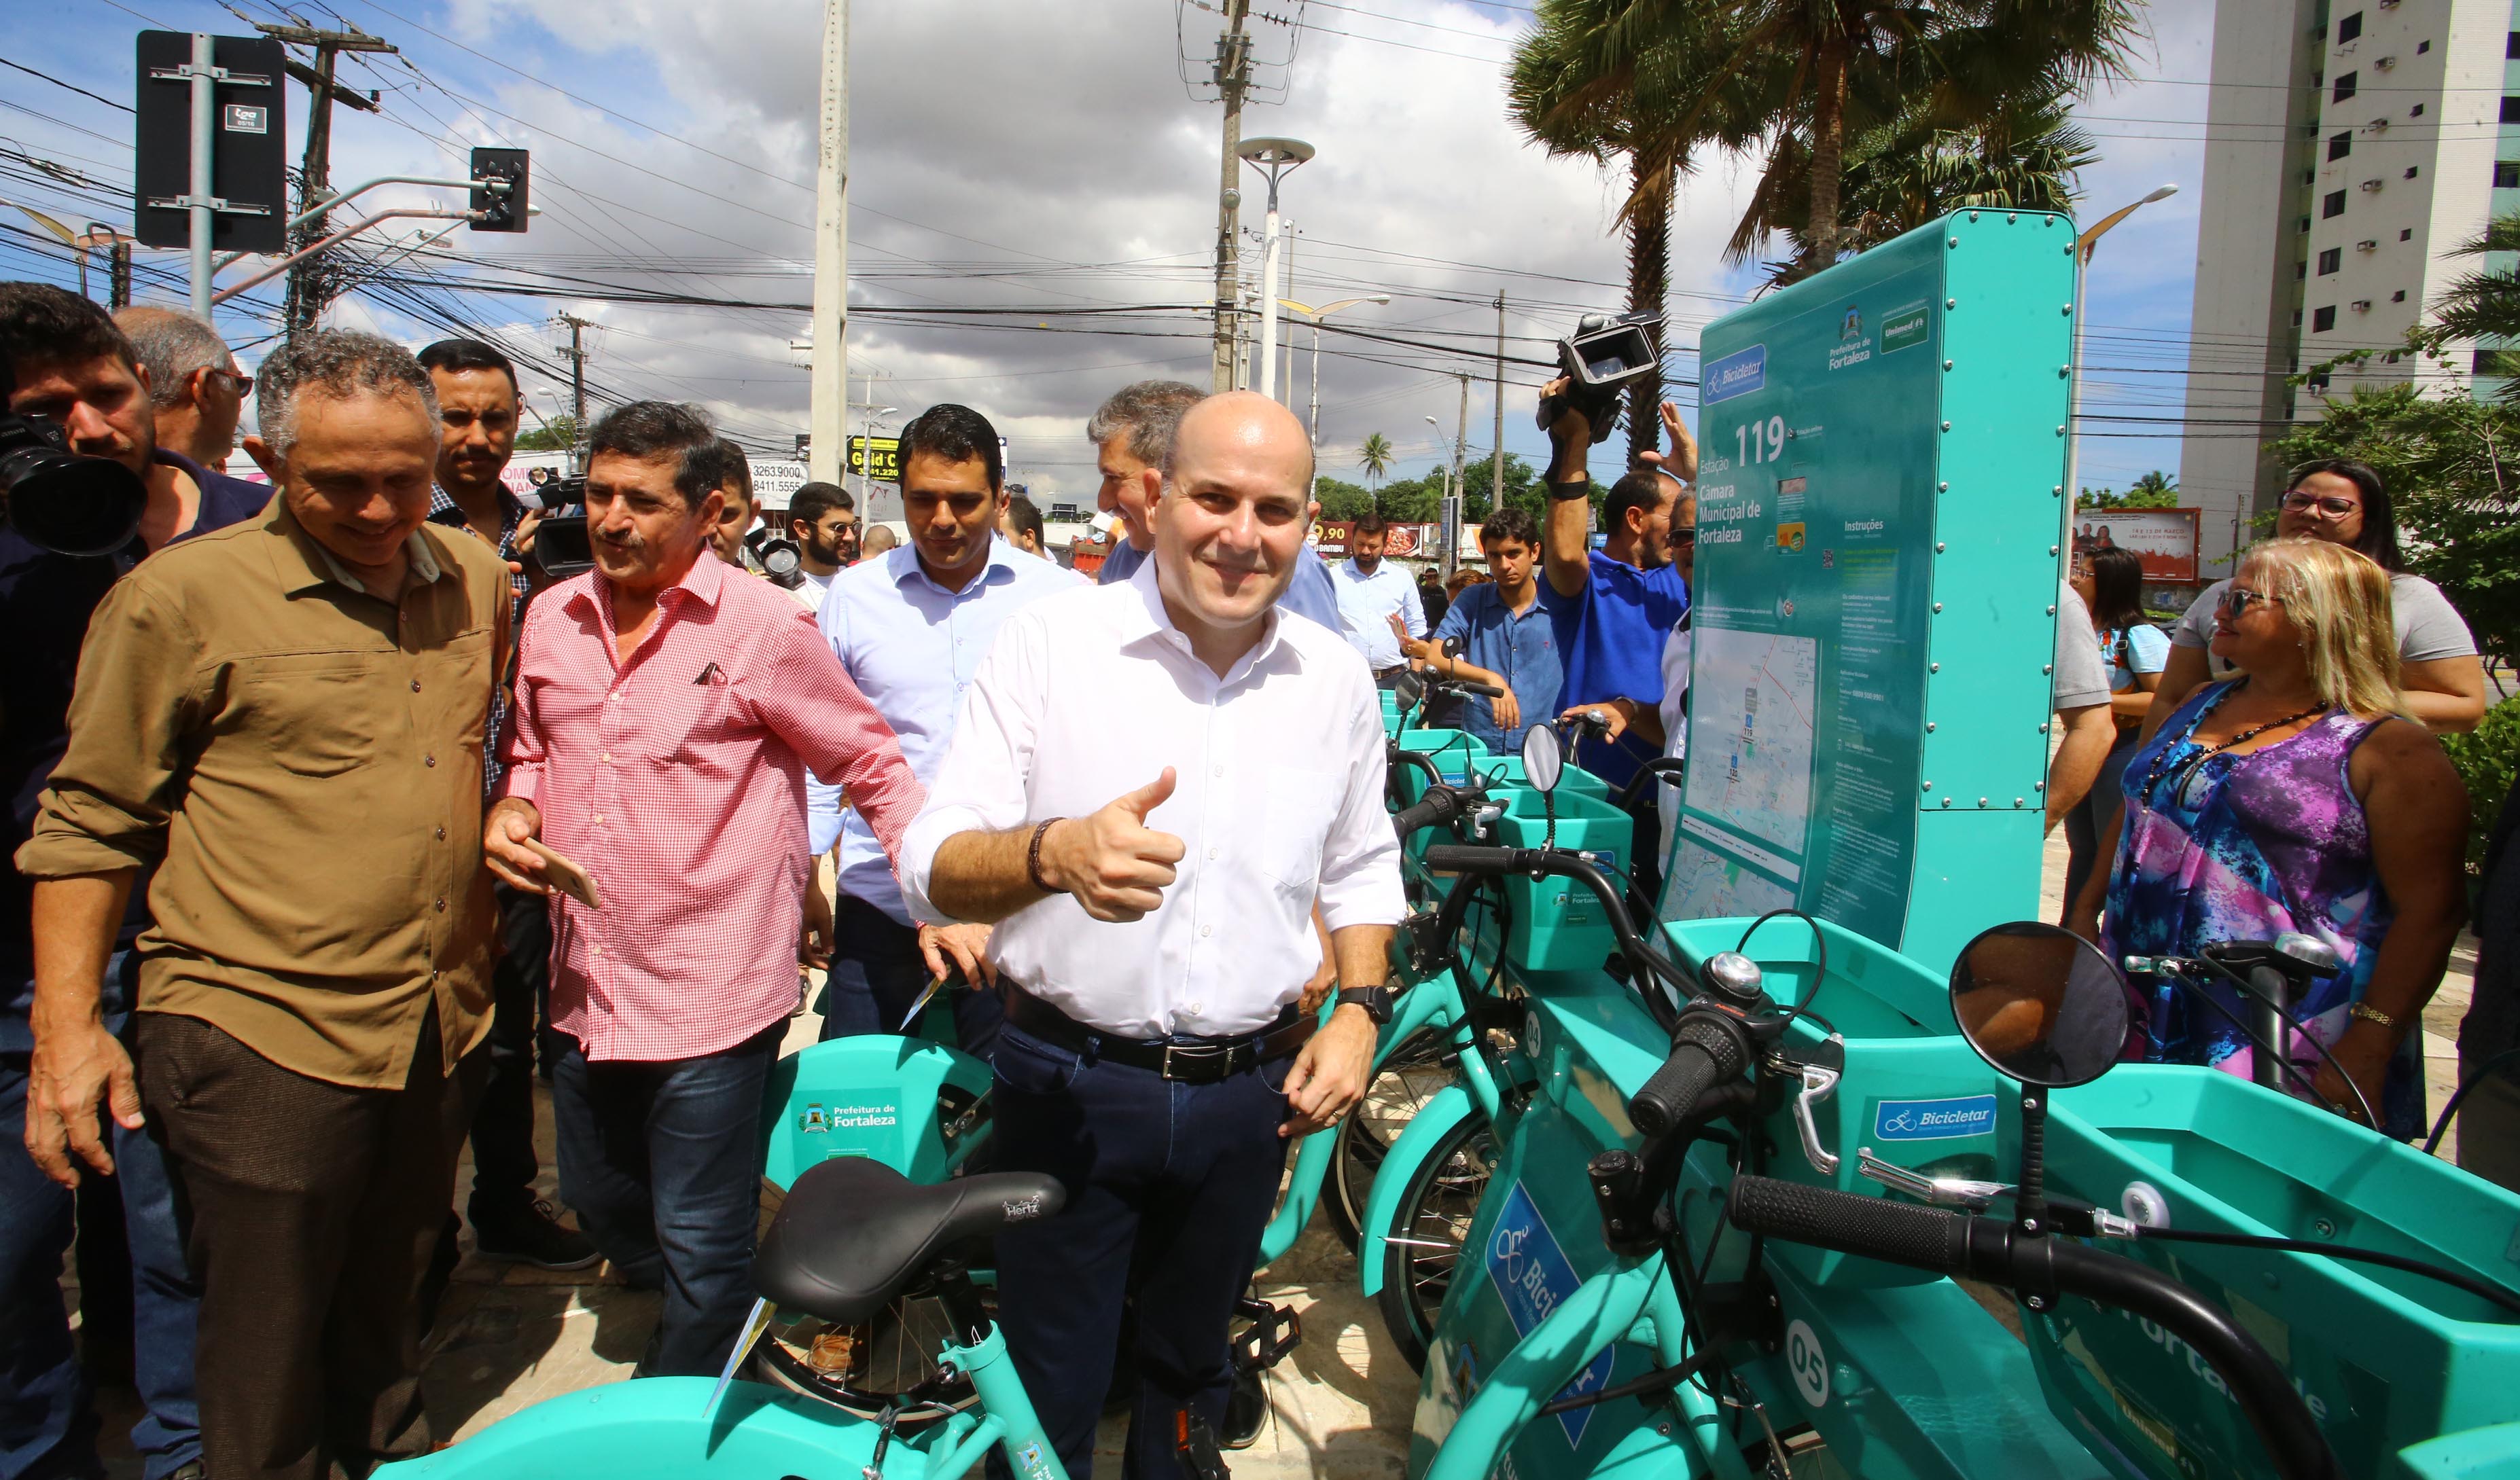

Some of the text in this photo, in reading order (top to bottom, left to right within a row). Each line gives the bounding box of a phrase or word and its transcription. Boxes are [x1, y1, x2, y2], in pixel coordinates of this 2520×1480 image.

[1885, 321, 1914, 337] Unimed
[1829, 337, 1871, 357] Prefeitura de
[1828, 350, 1870, 371] Fortaleza
[1722, 361, 1762, 385] Bicicletar
[1736, 416, 1785, 467] 119
[851, 452, 896, 467] Gld C
[1700, 456, 1729, 475] Estação
[753, 465, 800, 477] 3263.9000
[753, 480, 800, 492] 8411.5555
[1700, 484, 1735, 502] Câmara
[1699, 500, 1745, 524] Municipal
[1747, 499, 1761, 518] de
[1699, 525, 1742, 544] Fortaleza
[1844, 519, 1884, 533] Instruções
[1319, 544, 1344, 553] BAMBU
[834, 1104, 895, 1115] Prefeitura de
[1919, 1109, 1990, 1126] Bicicletar
[834, 1114, 896, 1127] Fortaleza
[1007, 1204, 1038, 1216] Hertz
[1792, 1333, 1823, 1393] 05
